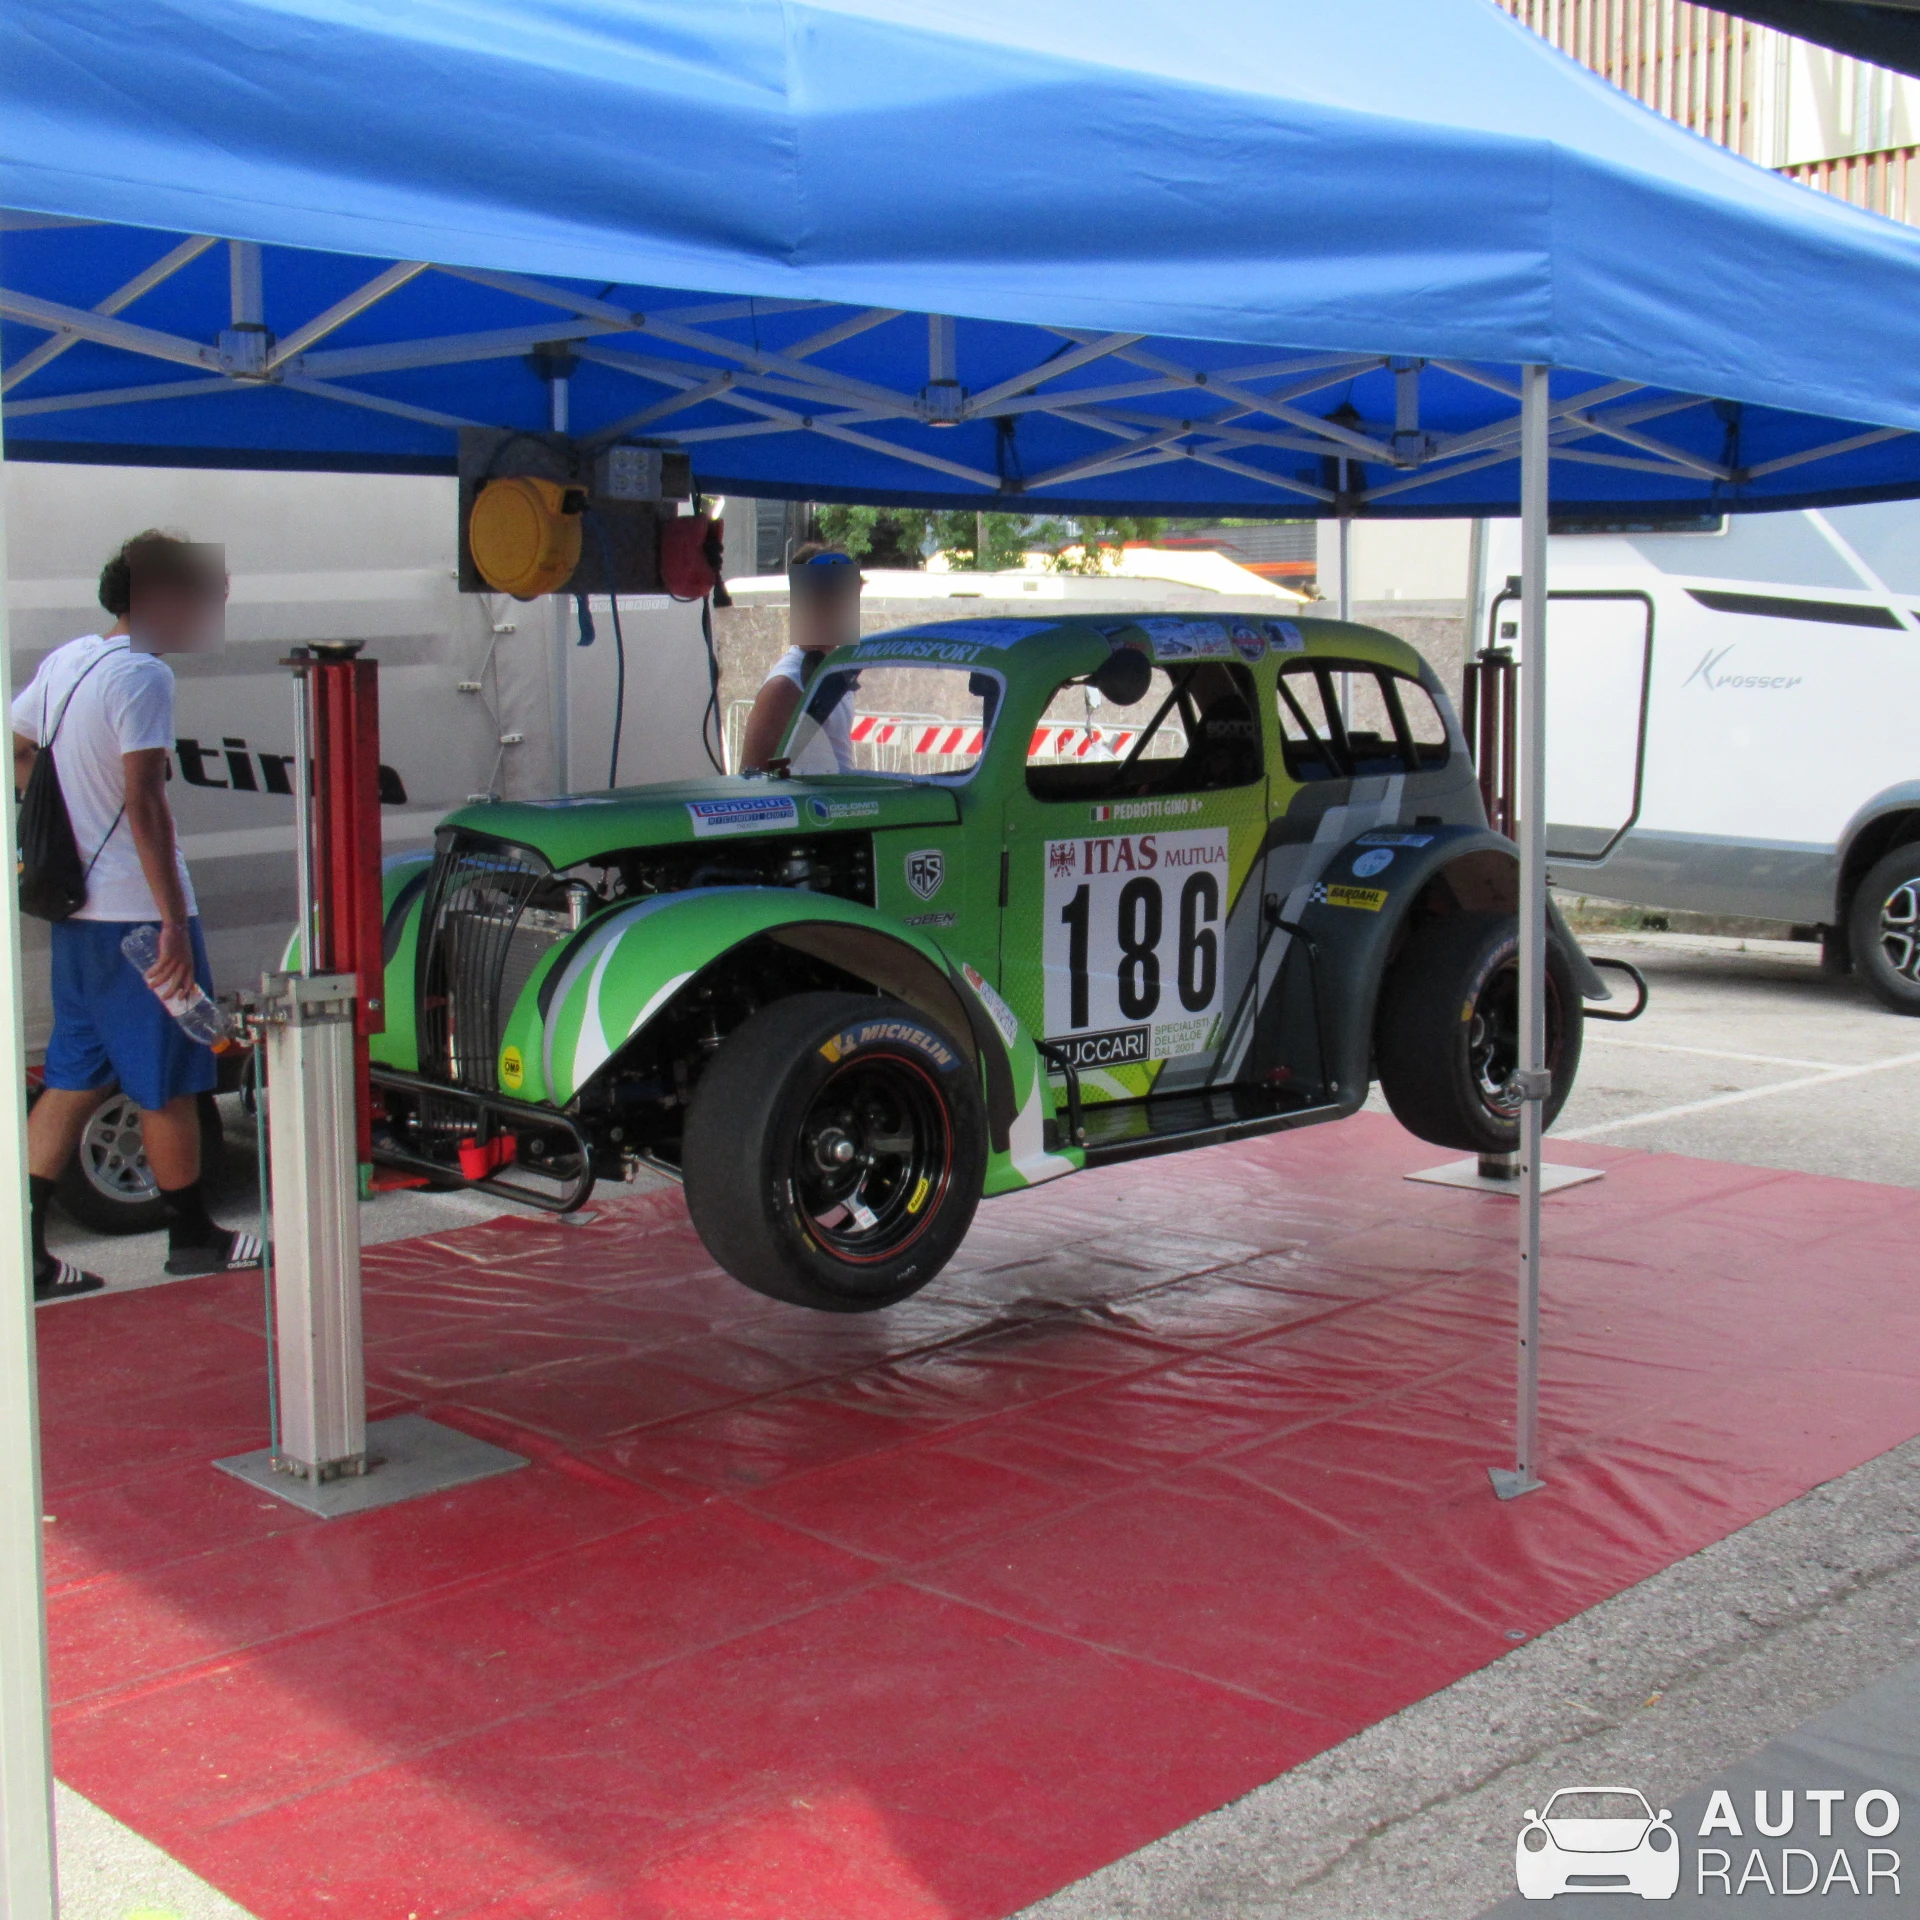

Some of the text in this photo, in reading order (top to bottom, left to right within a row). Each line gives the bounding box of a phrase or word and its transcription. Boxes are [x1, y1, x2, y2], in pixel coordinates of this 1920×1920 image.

[1680, 643, 1804, 692] Krosser
[1113, 801, 1162, 820] PEDROTTI
[1164, 799, 1188, 815] GINO
[1083, 835, 1227, 875] ITAS MUTUA
[1331, 887, 1379, 904] BARDAHL
[1061, 870, 1219, 1029] 186
[1155, 1017, 1209, 1035] SPECIALISTI
[860, 1024, 952, 1065] MICHELIN
[1154, 1042, 1194, 1057] DAL 2001
[505, 1061, 520, 1073] OMP
